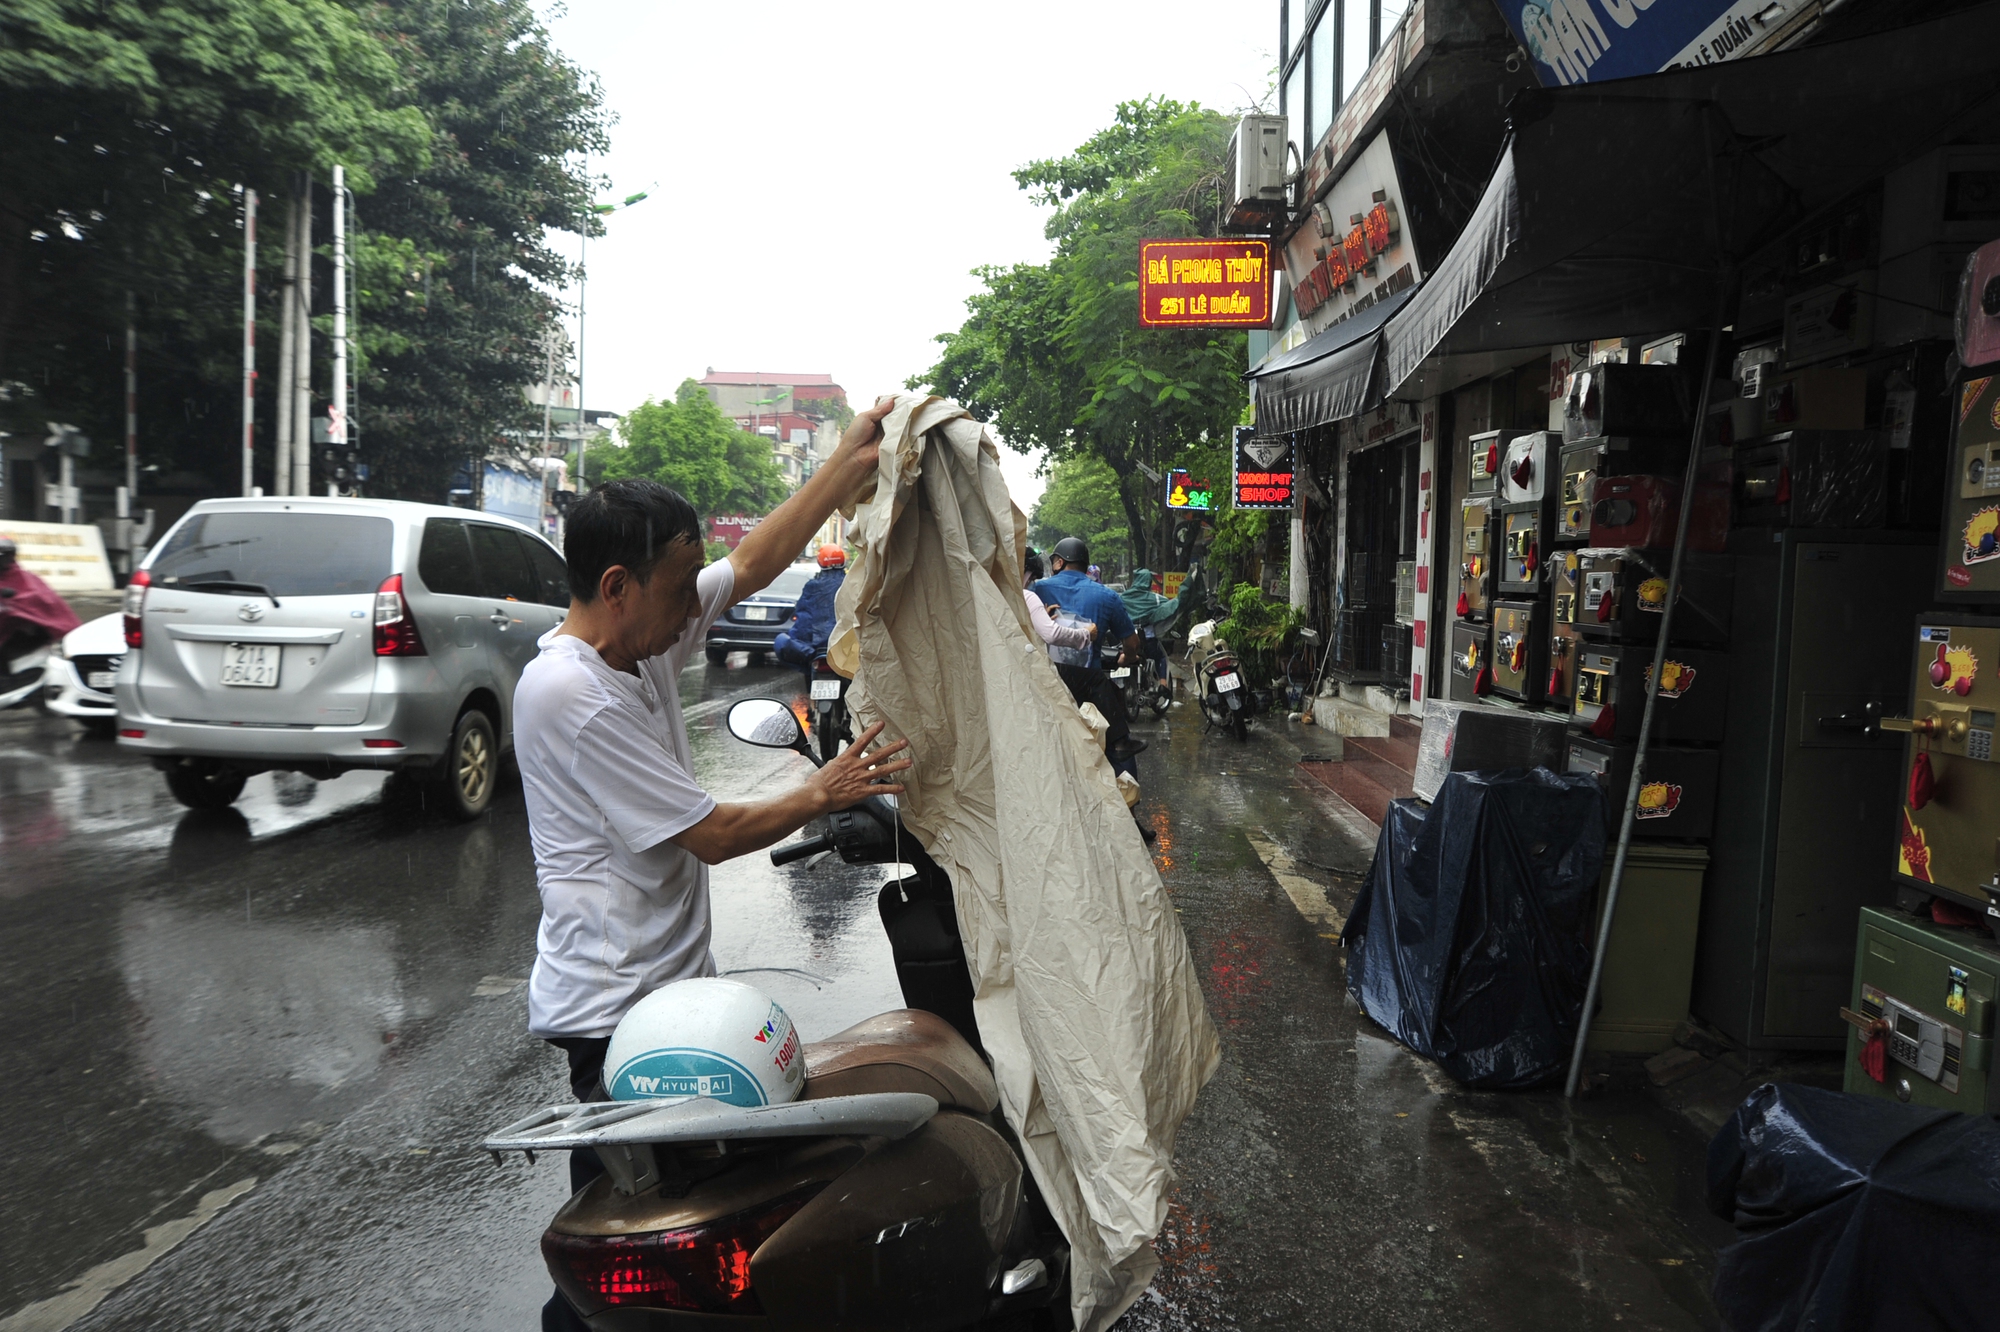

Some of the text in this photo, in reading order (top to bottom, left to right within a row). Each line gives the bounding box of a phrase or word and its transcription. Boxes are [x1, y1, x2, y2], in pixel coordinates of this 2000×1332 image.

[1710, 14, 1754, 61] DUẨN
[1148, 250, 1262, 284] ĐÁ PHONG THỦY
[1160, 297, 1185, 315] 251
[1190, 293, 1207, 315] LÊ
[1422, 411, 1433, 442] 251
[1238, 472, 1292, 485] MOON PET
[1240, 487, 1290, 502] SHOP
[1168, 574, 1187, 582] CHU
[628, 1074, 725, 1092] VTV HYUNDAI
